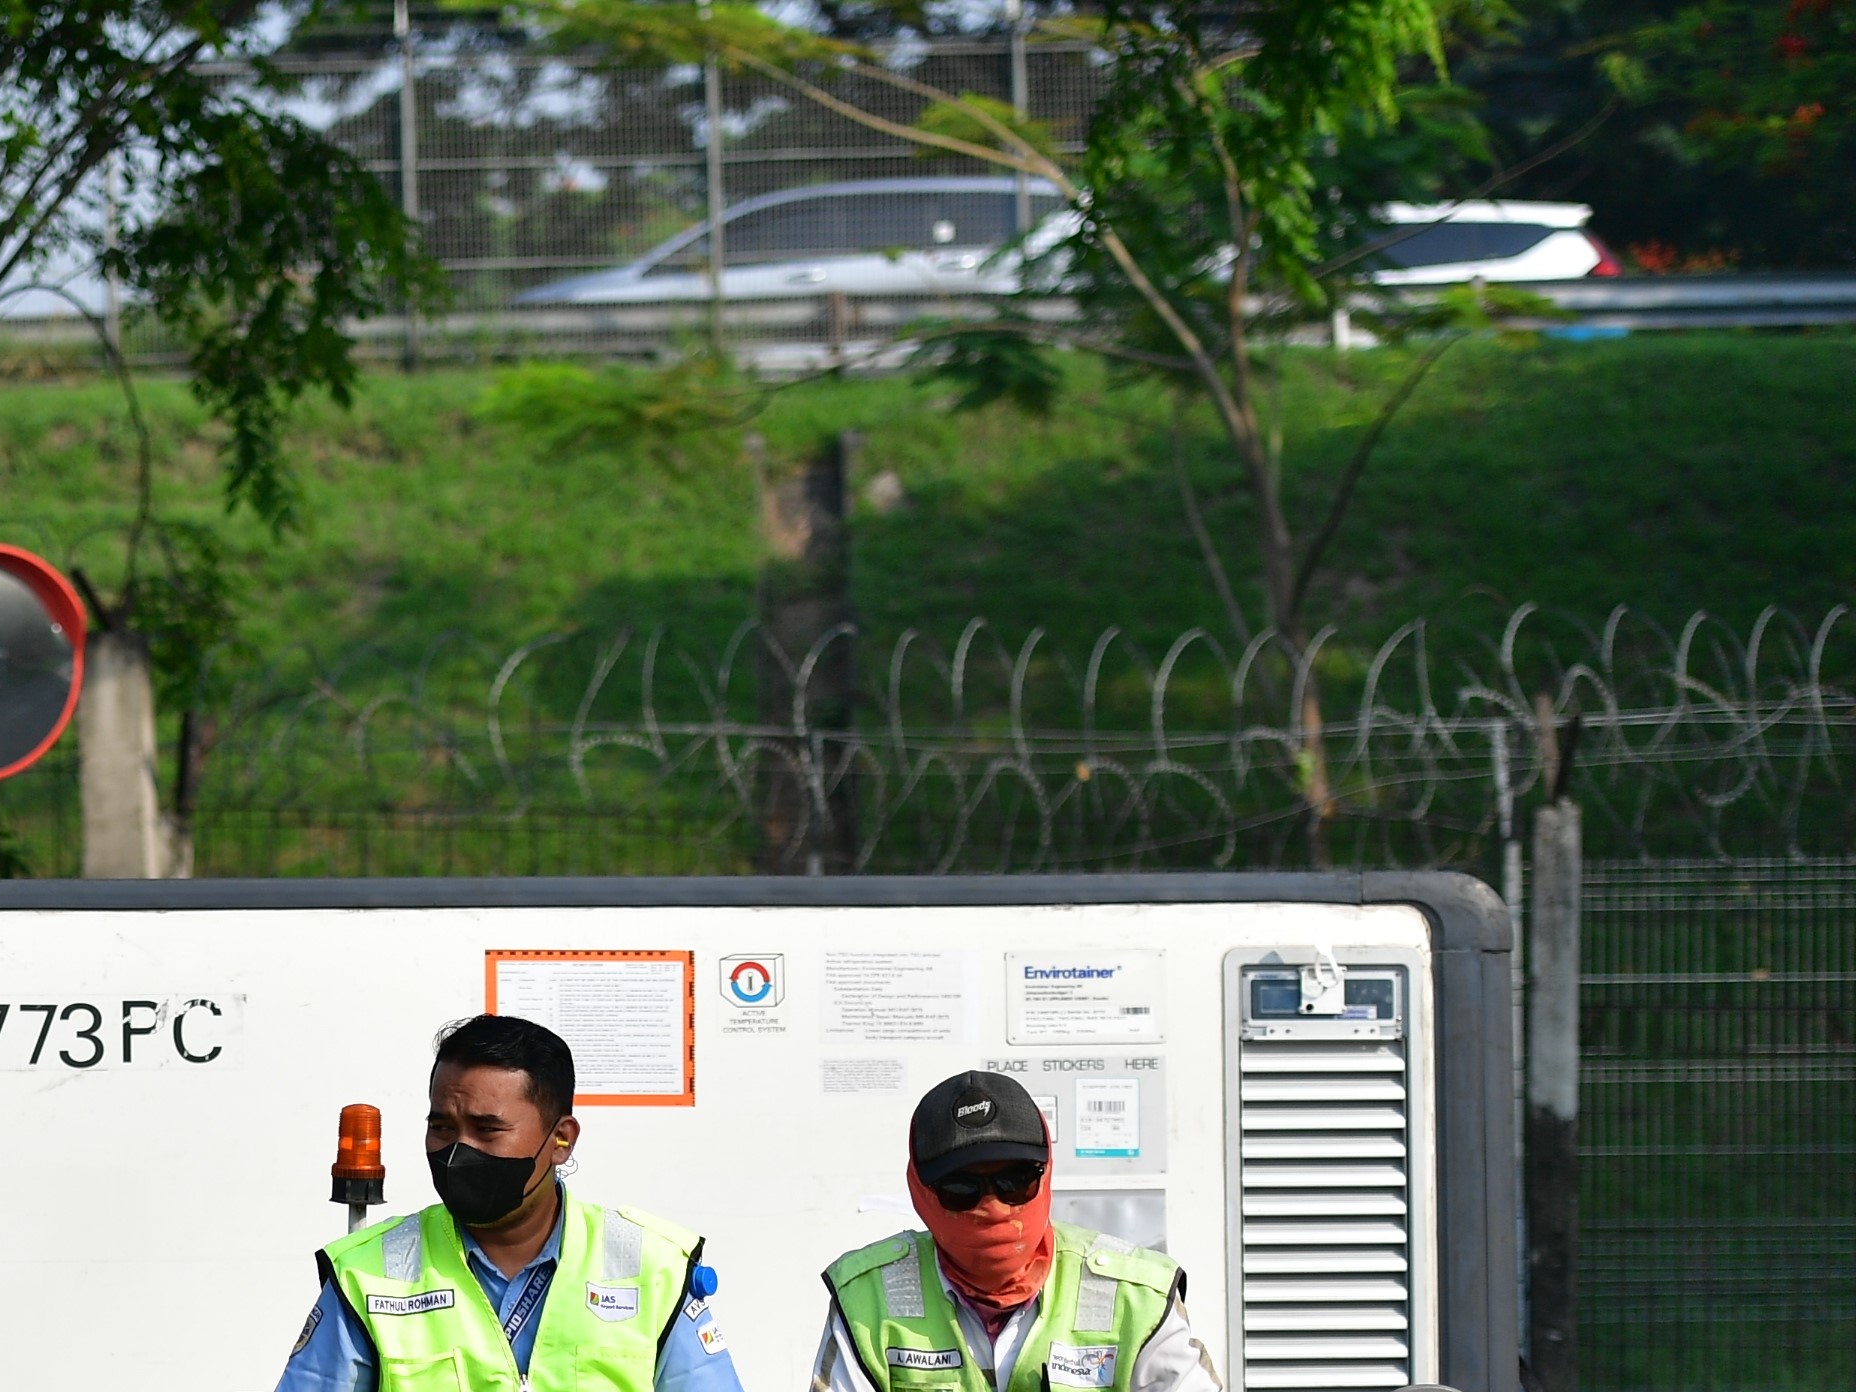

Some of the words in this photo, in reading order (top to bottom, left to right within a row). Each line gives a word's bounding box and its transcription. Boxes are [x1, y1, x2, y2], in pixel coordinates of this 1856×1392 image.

[987, 1060, 1029, 1073] PLACE
[1042, 1058, 1105, 1072] STICKERS
[1124, 1058, 1159, 1071] HERE
[957, 1100, 992, 1118] Bloods
[374, 1299, 405, 1312] FATHUL
[407, 1293, 448, 1311] ROHMAN
[905, 1352, 952, 1366] AWALANI
